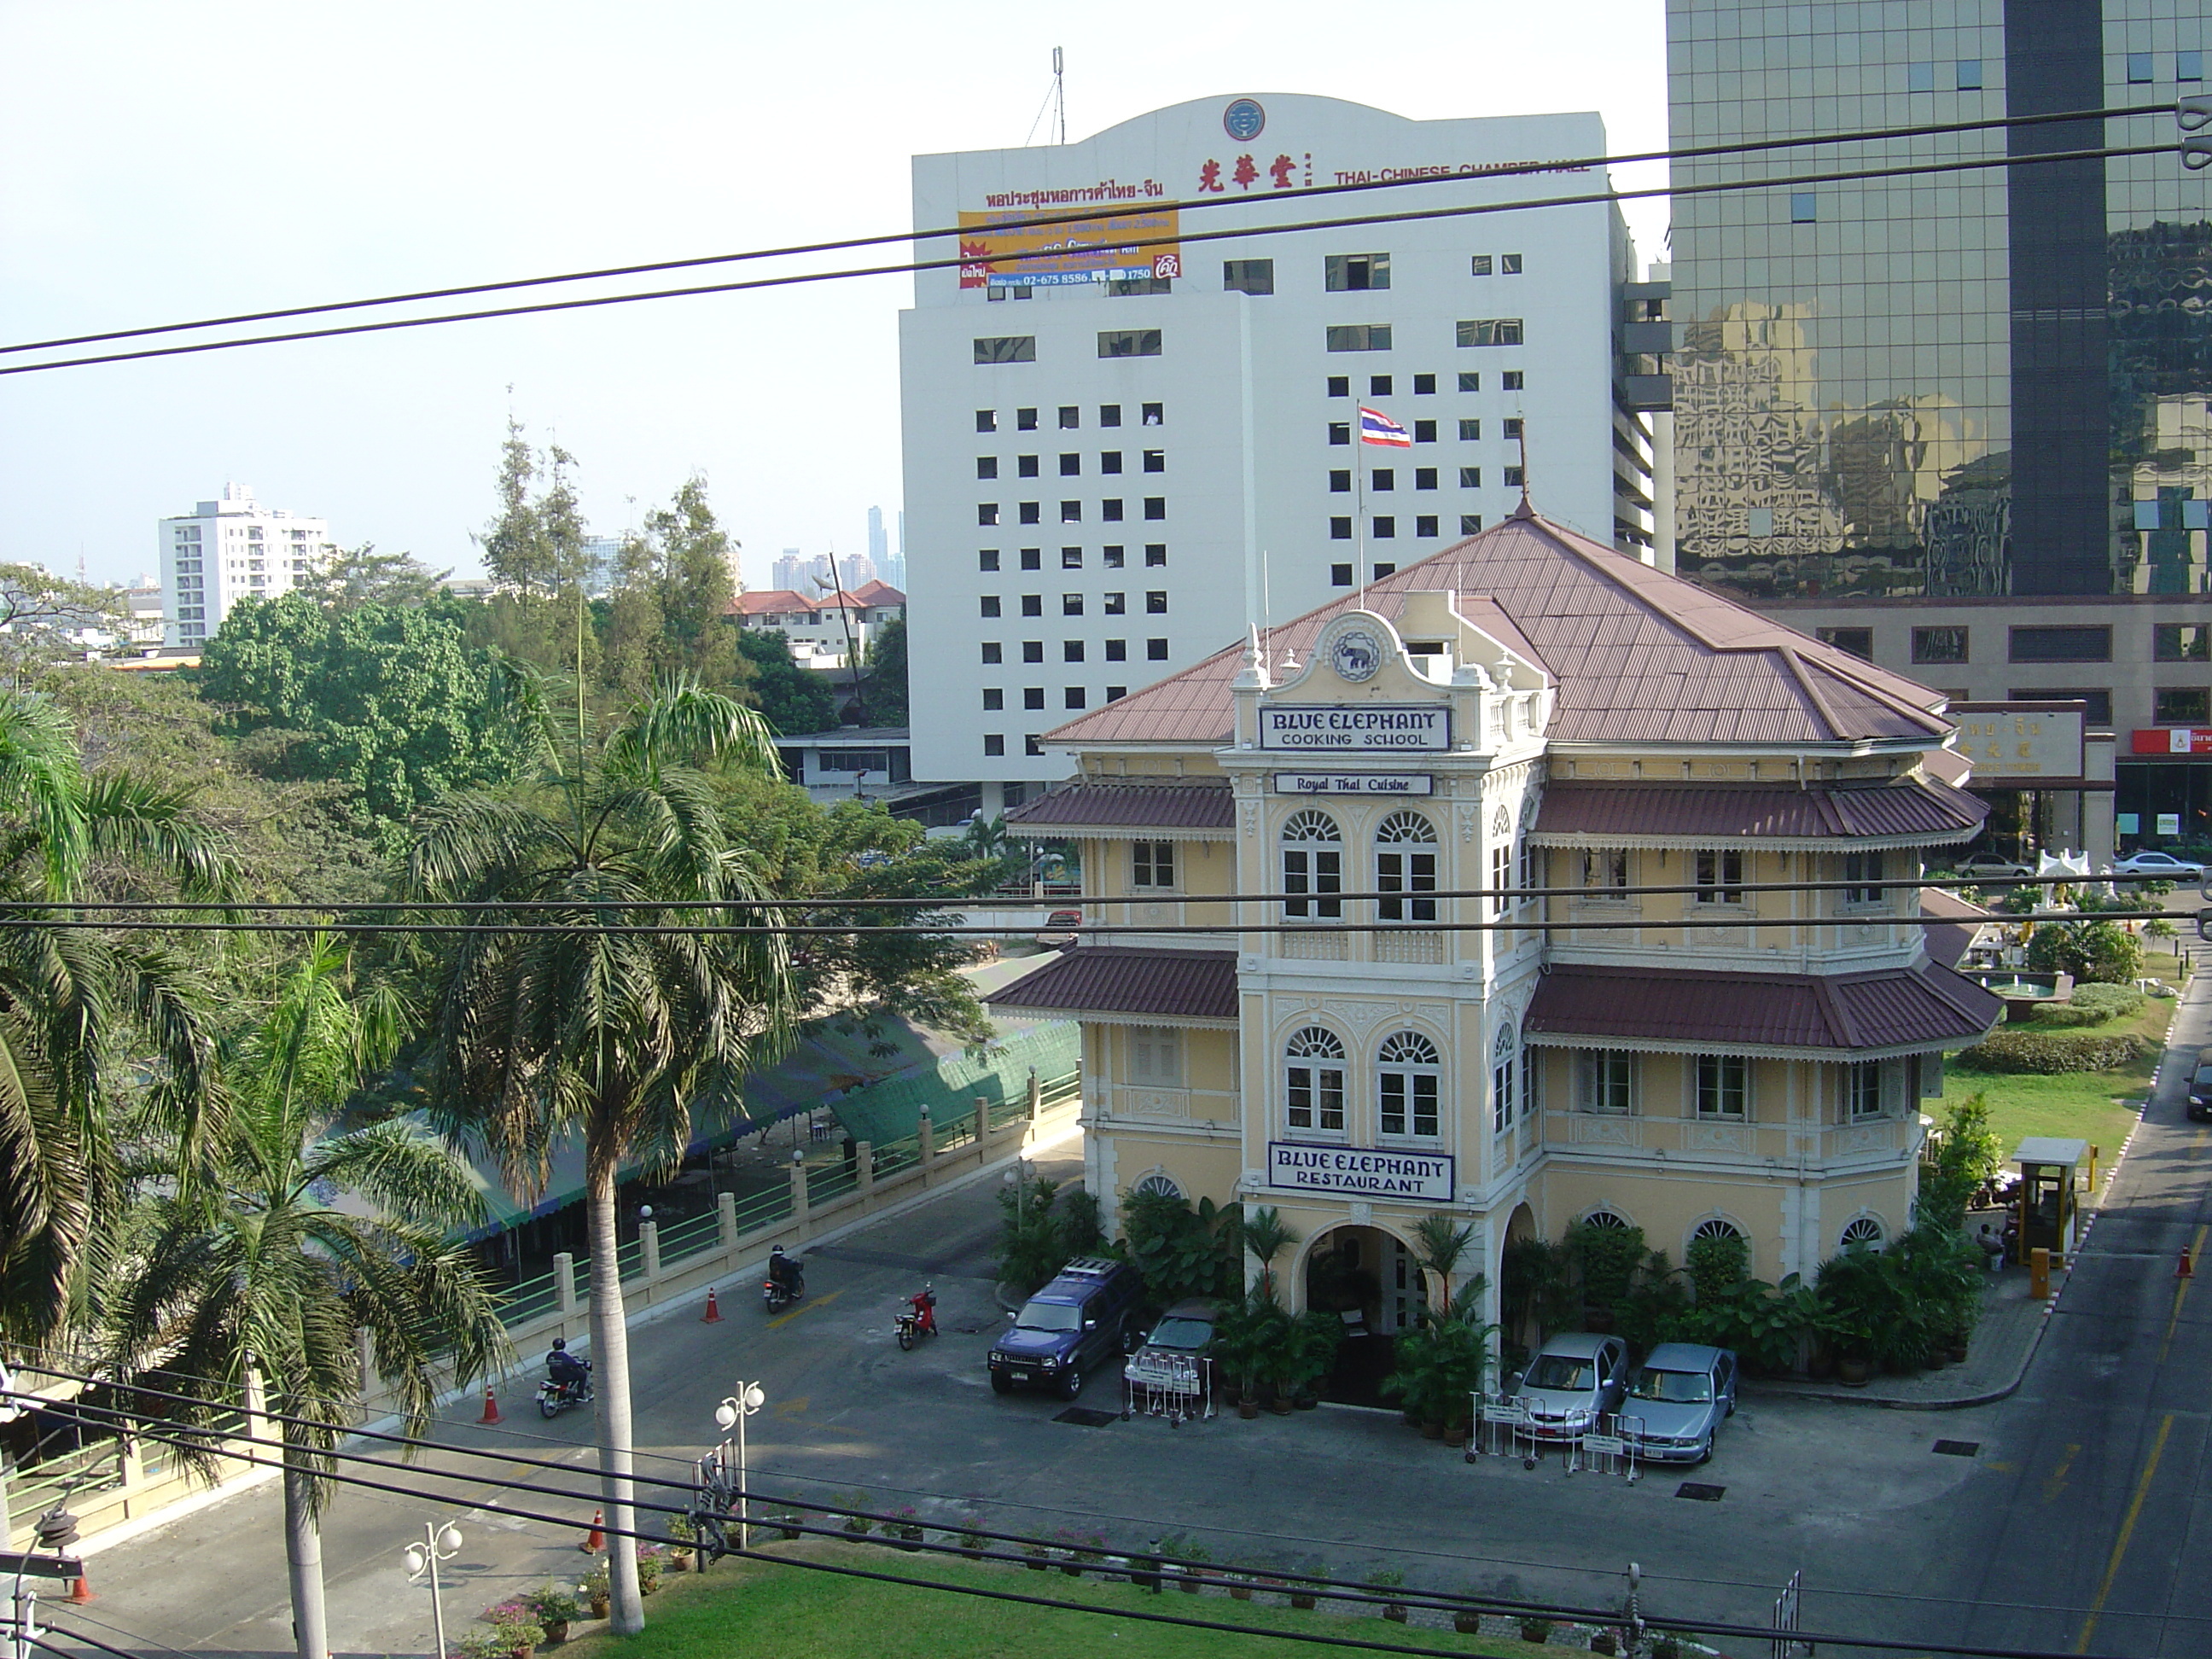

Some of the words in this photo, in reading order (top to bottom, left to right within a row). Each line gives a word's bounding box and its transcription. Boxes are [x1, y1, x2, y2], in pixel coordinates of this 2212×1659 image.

[1334, 166, 1450, 185] THAI-CHINESE
[986, 179, 1163, 209] หอประชุมหอการค้าไทย-จีน
[1024, 275, 1059, 285] 02-675
[1128, 269, 1150, 279] 1750
[1272, 713, 1324, 730] BLUE
[1329, 713, 1435, 731] ELEPHANT
[1282, 734, 1352, 745] COOKING
[1364, 734, 1428, 745] SCHOOL
[1297, 777, 1329, 791] Royal
[1335, 777, 1360, 790] Thai
[1368, 778, 1409, 790] Cuisine
[1278, 1150, 1330, 1169] BLUE
[1335, 1154, 1444, 1178] ELEPHANT
[1296, 1171, 1424, 1193] RESTAURANT
